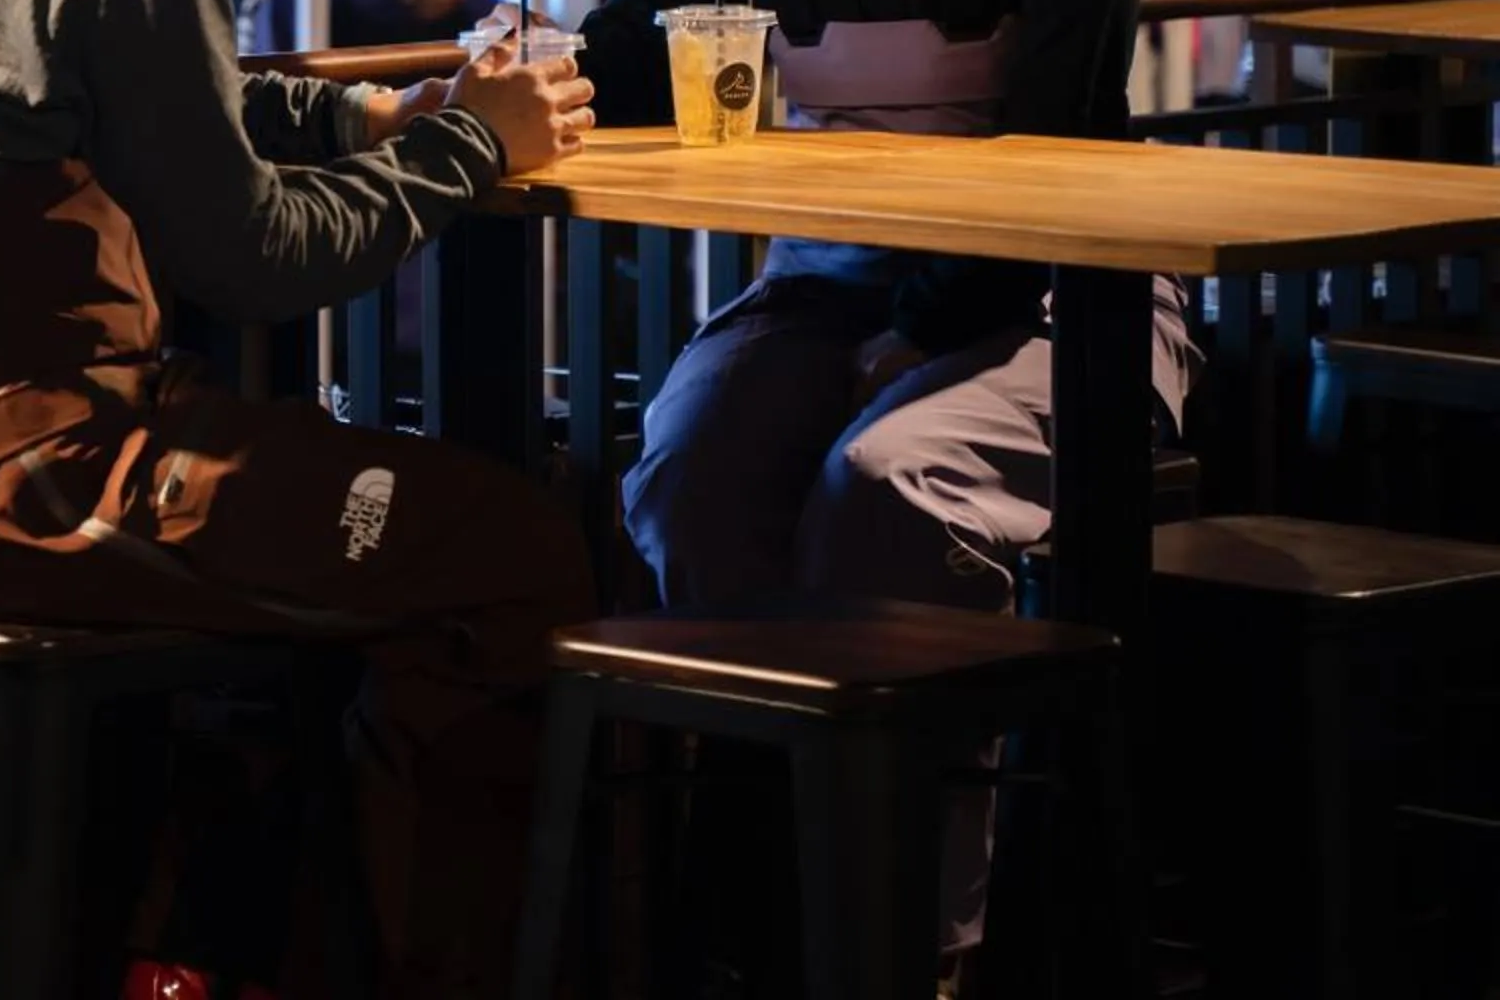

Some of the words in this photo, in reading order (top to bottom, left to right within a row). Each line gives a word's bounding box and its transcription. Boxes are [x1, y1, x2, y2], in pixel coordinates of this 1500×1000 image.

[339, 493, 360, 527] THE
[344, 497, 375, 561] NORTH
[363, 501, 387, 548] FACE
